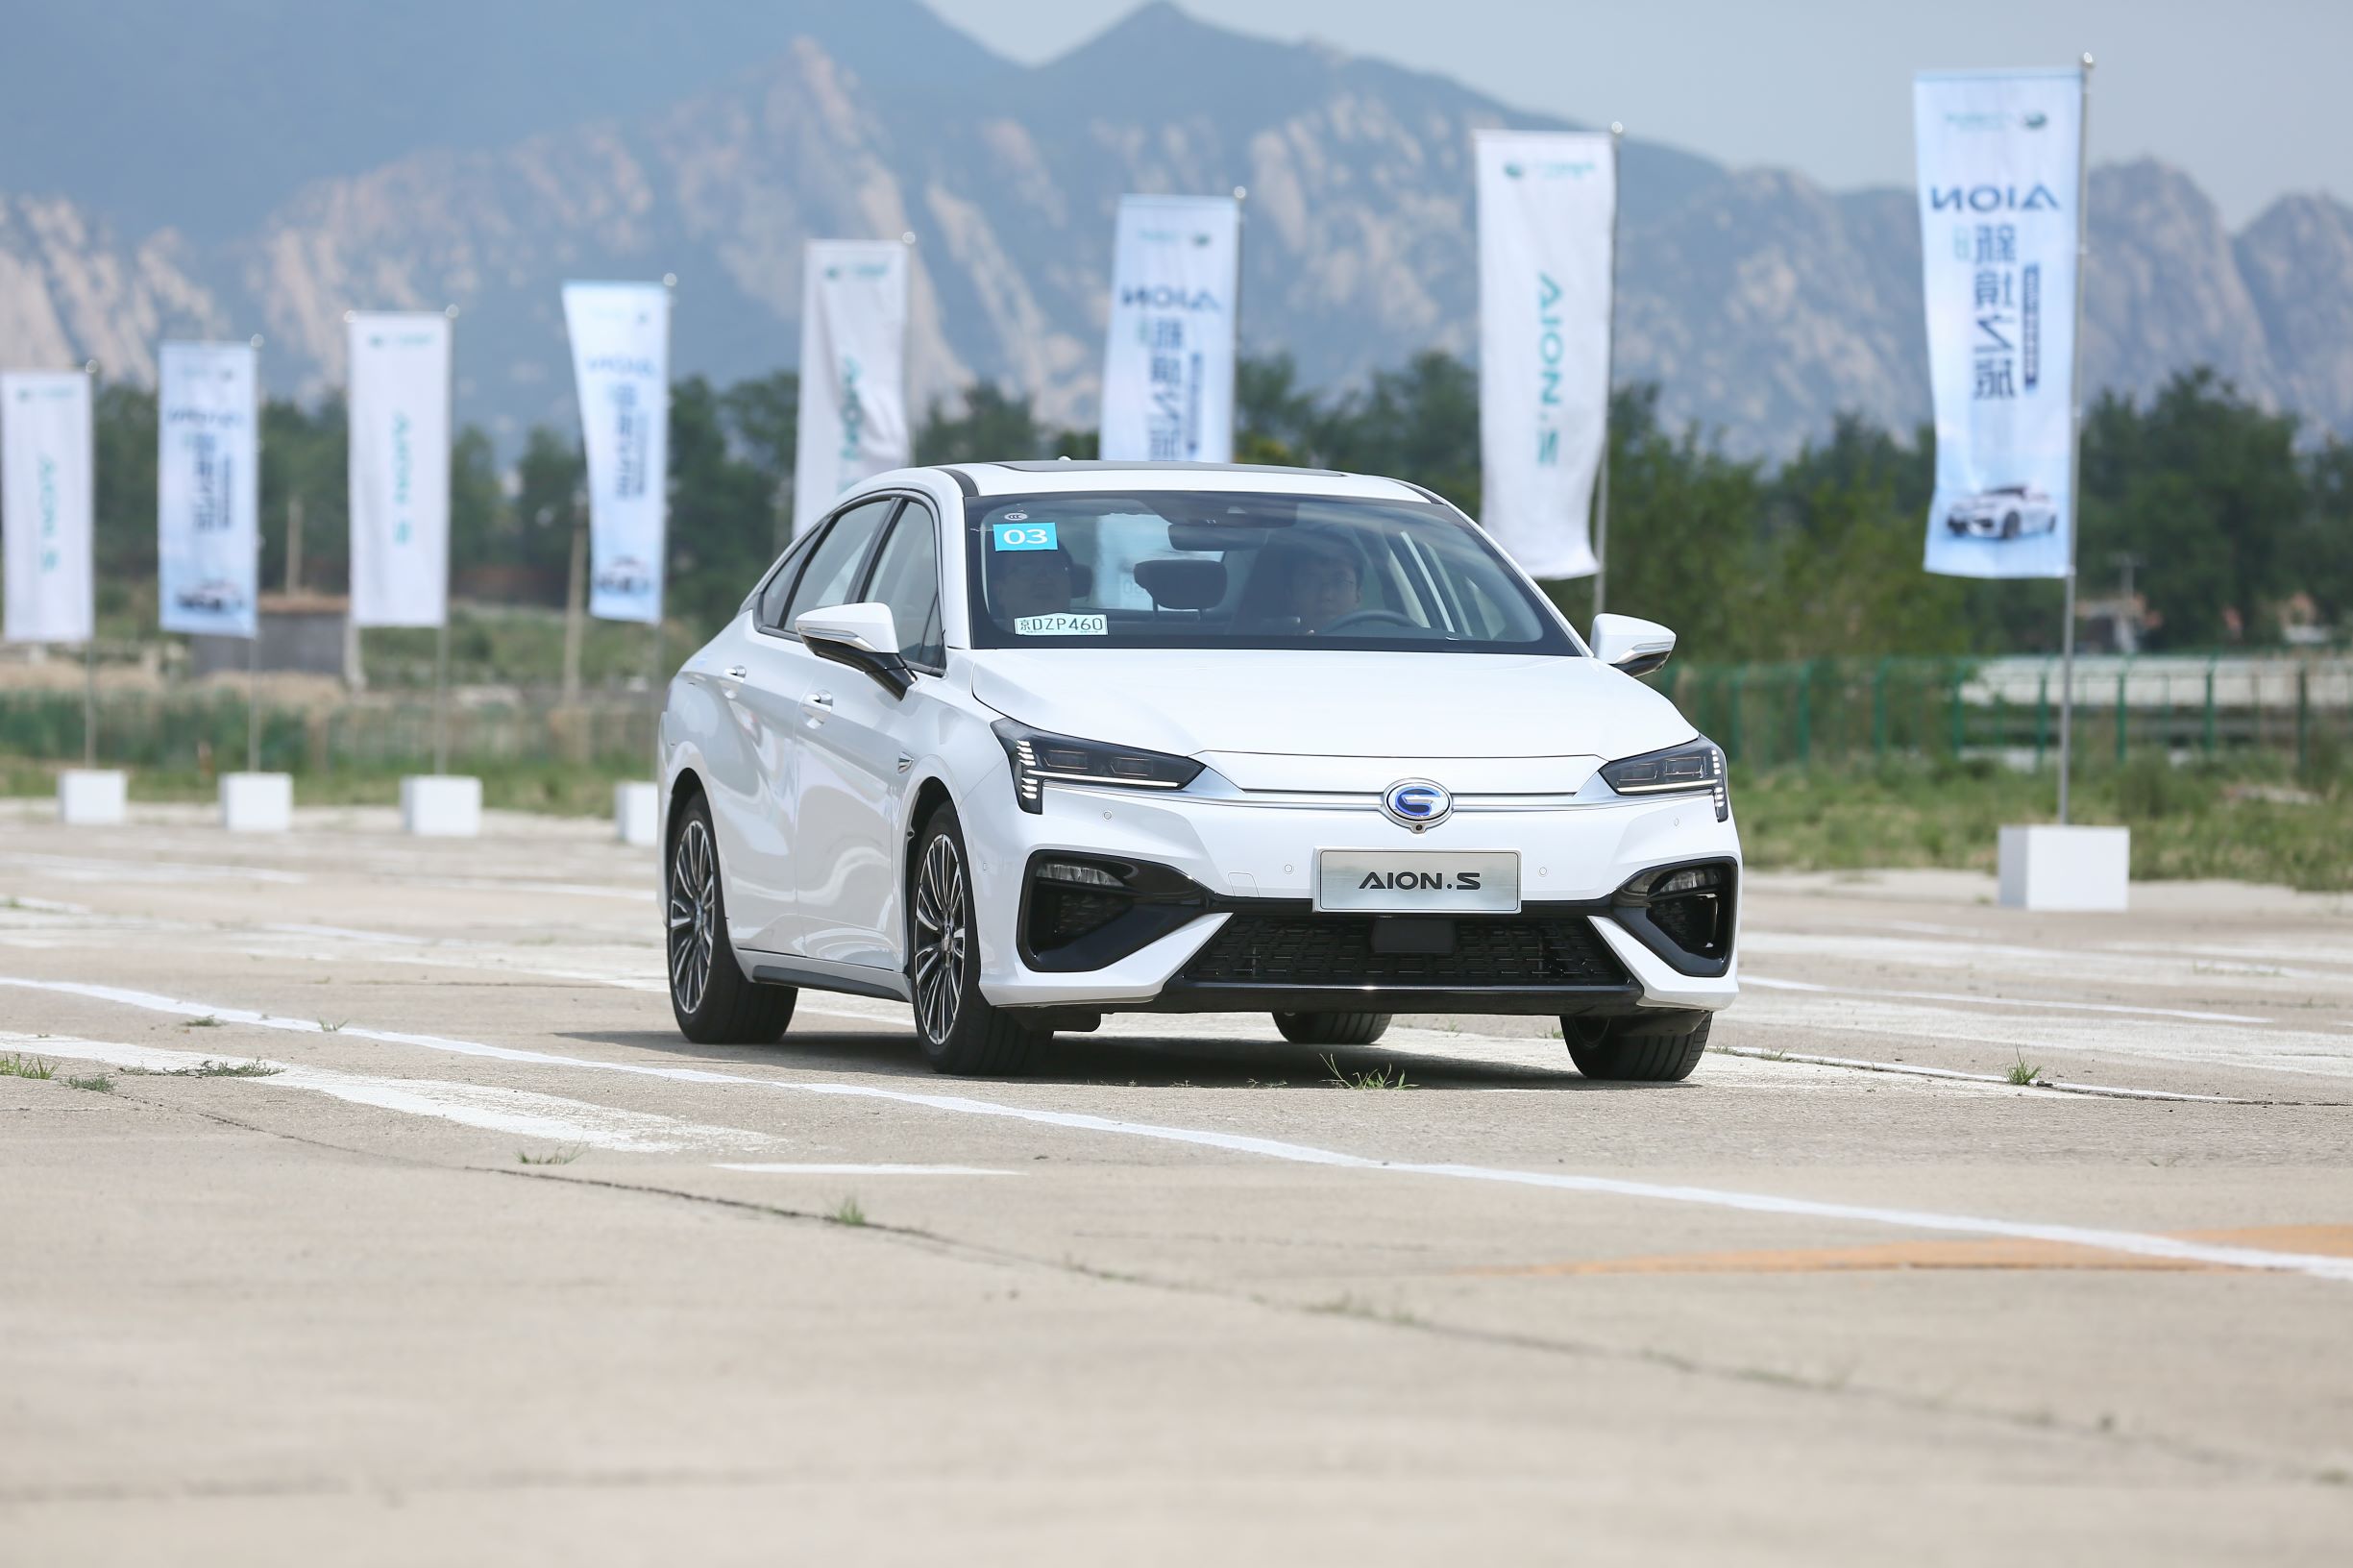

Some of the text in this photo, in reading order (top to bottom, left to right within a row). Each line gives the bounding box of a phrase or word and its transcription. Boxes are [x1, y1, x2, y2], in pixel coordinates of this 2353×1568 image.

[1538, 272, 1562, 465] AION.S
[1003, 528, 1048, 545] 03
[1019, 618, 1103, 631] 京DZP460
[1359, 871, 1482, 890] AION.S
